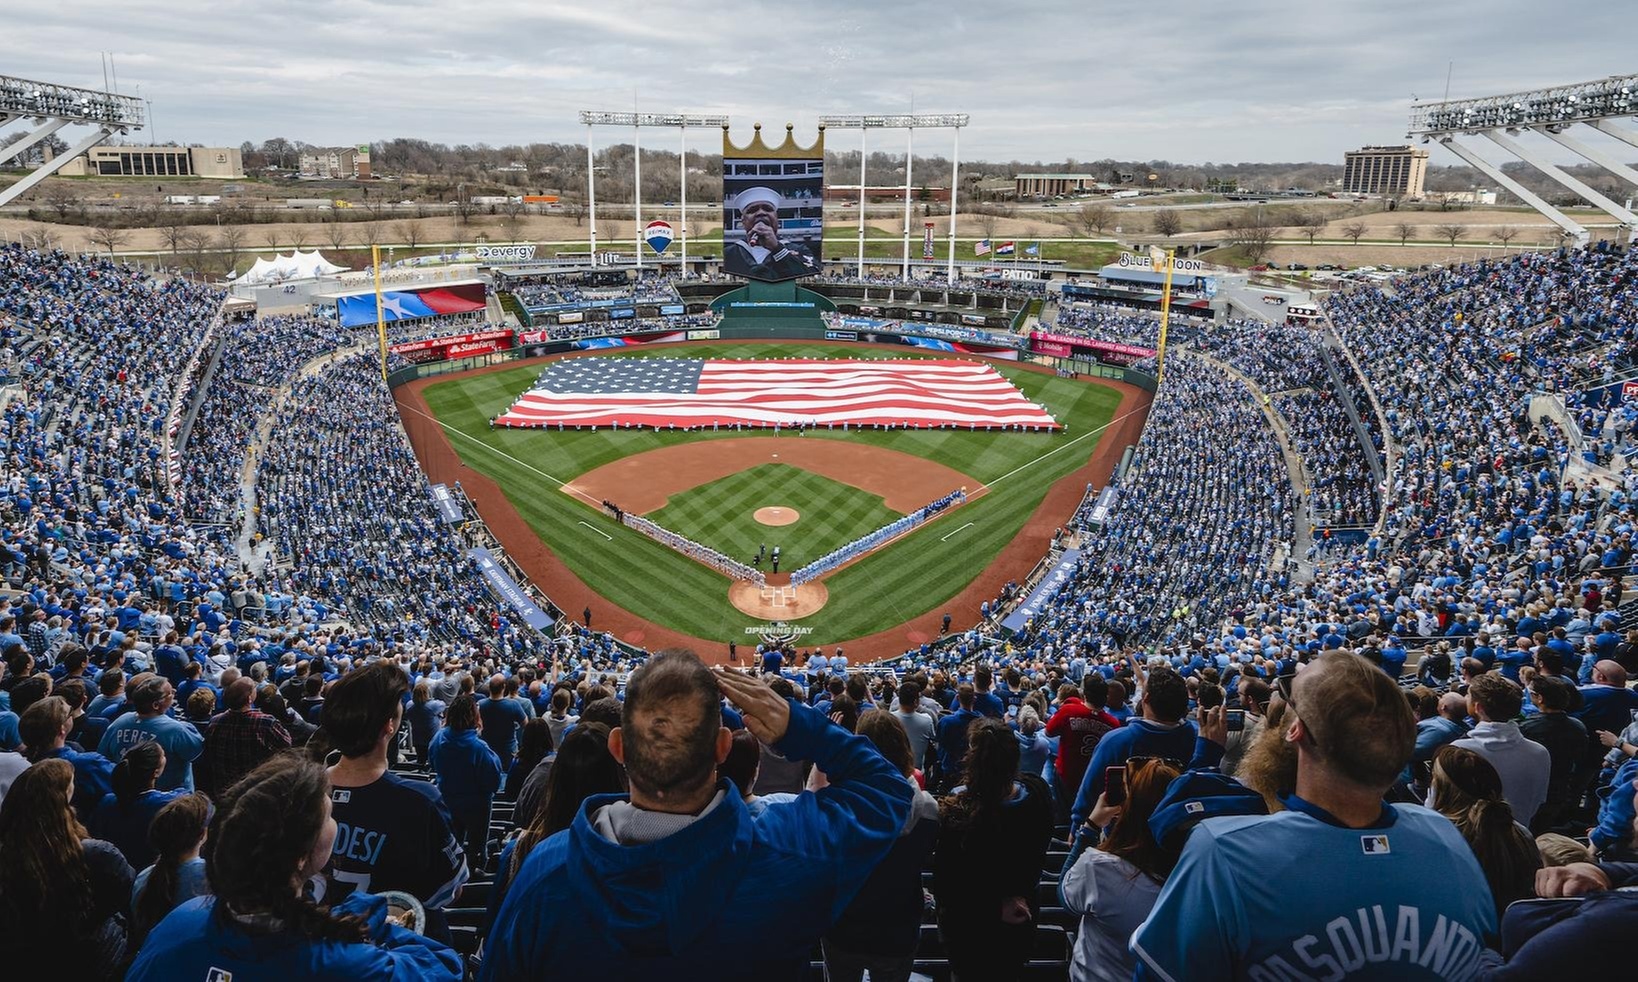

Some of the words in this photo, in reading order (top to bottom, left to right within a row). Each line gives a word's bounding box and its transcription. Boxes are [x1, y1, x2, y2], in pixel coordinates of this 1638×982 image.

[491, 247, 535, 259] evergy
[600, 252, 620, 266] Lite
[1120, 252, 1149, 267] BLUE
[1002, 269, 1033, 280] PATIO
[284, 285, 296, 294] 42
[745, 626, 792, 634] OPENING
[116, 728, 157, 745] PEREZ
